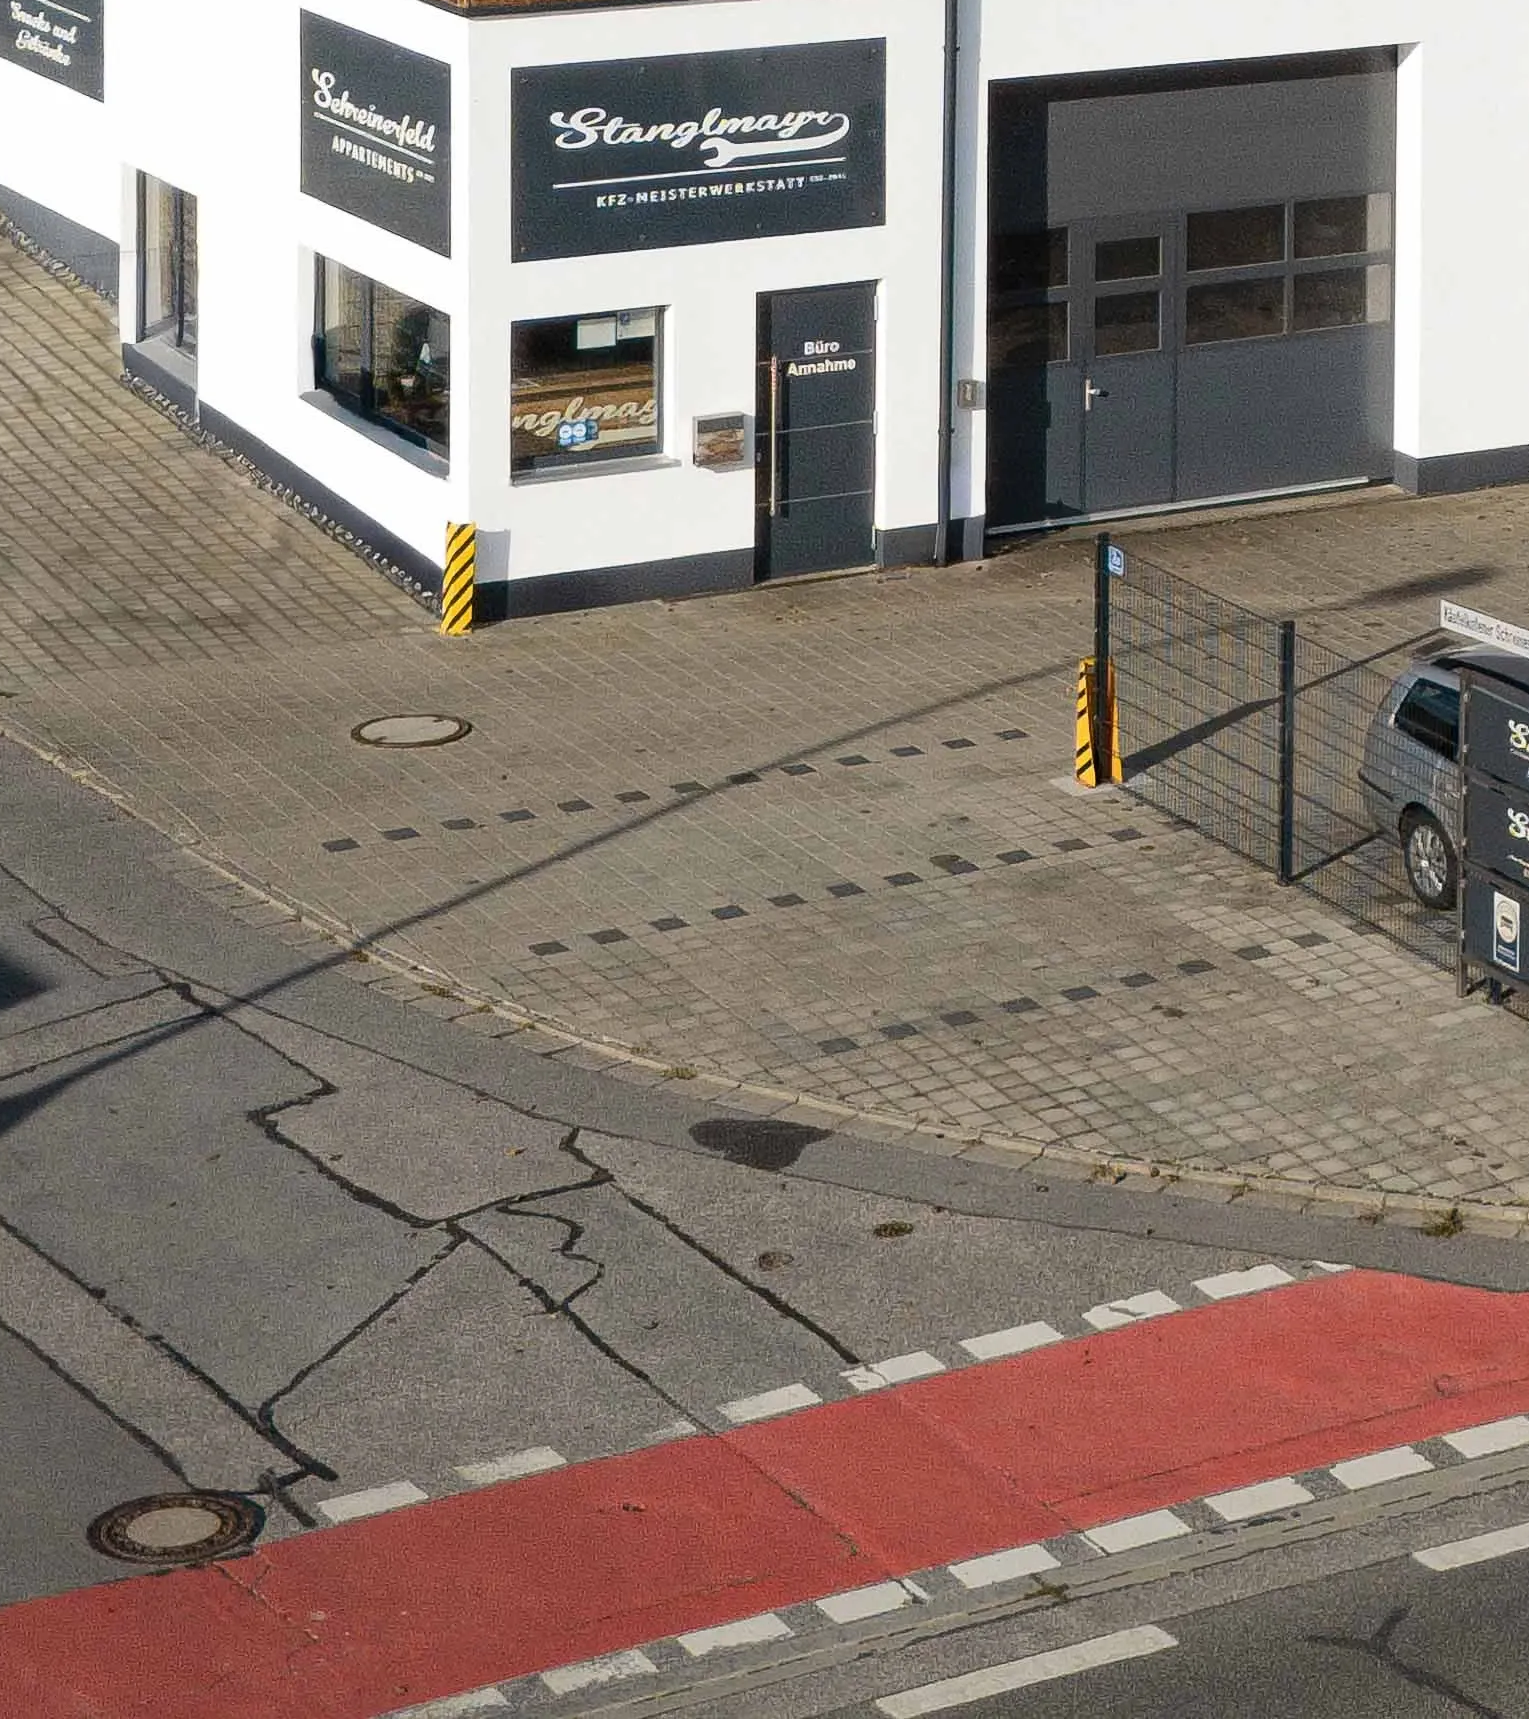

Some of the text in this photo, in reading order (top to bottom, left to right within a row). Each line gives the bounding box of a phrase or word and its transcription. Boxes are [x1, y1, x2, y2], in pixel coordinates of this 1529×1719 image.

[311, 68, 436, 153] Schreinerfeld
[549, 107, 843, 153] Stanglmayr
[331, 135, 414, 183] APPARTEMENTS
[596, 176, 806, 209] KFZ-MEISTERWERKSTATT
[787, 358, 857, 377] Annahme
[804, 341, 840, 356] Büro
